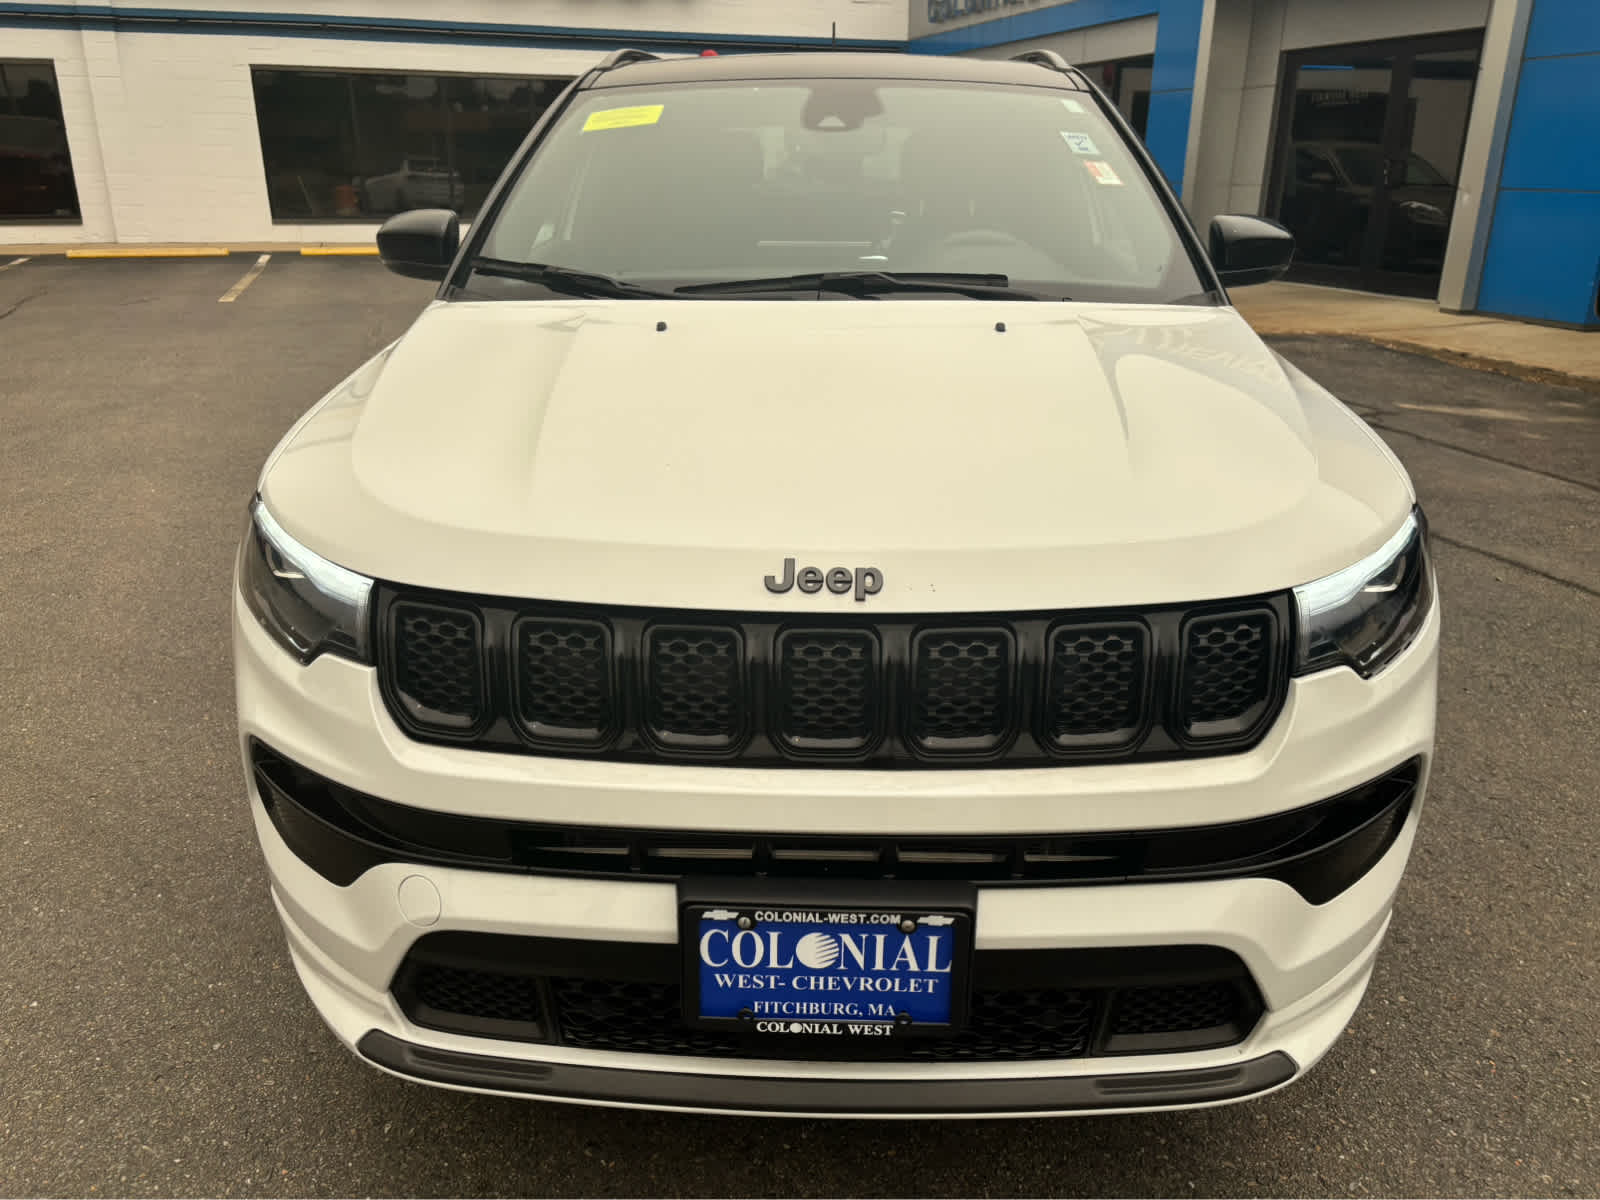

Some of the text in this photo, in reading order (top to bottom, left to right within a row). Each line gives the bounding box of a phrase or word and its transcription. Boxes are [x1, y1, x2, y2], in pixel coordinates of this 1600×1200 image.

[764, 557, 884, 602] Jeep
[754, 911, 899, 924] COLONIAL-WEST.COM
[700, 928, 952, 972] COLONIAL
[791, 975, 939, 993] CHEVROLET
[868, 1003, 896, 1017] MA
[756, 1021, 894, 1036] COLONIAL WEST
